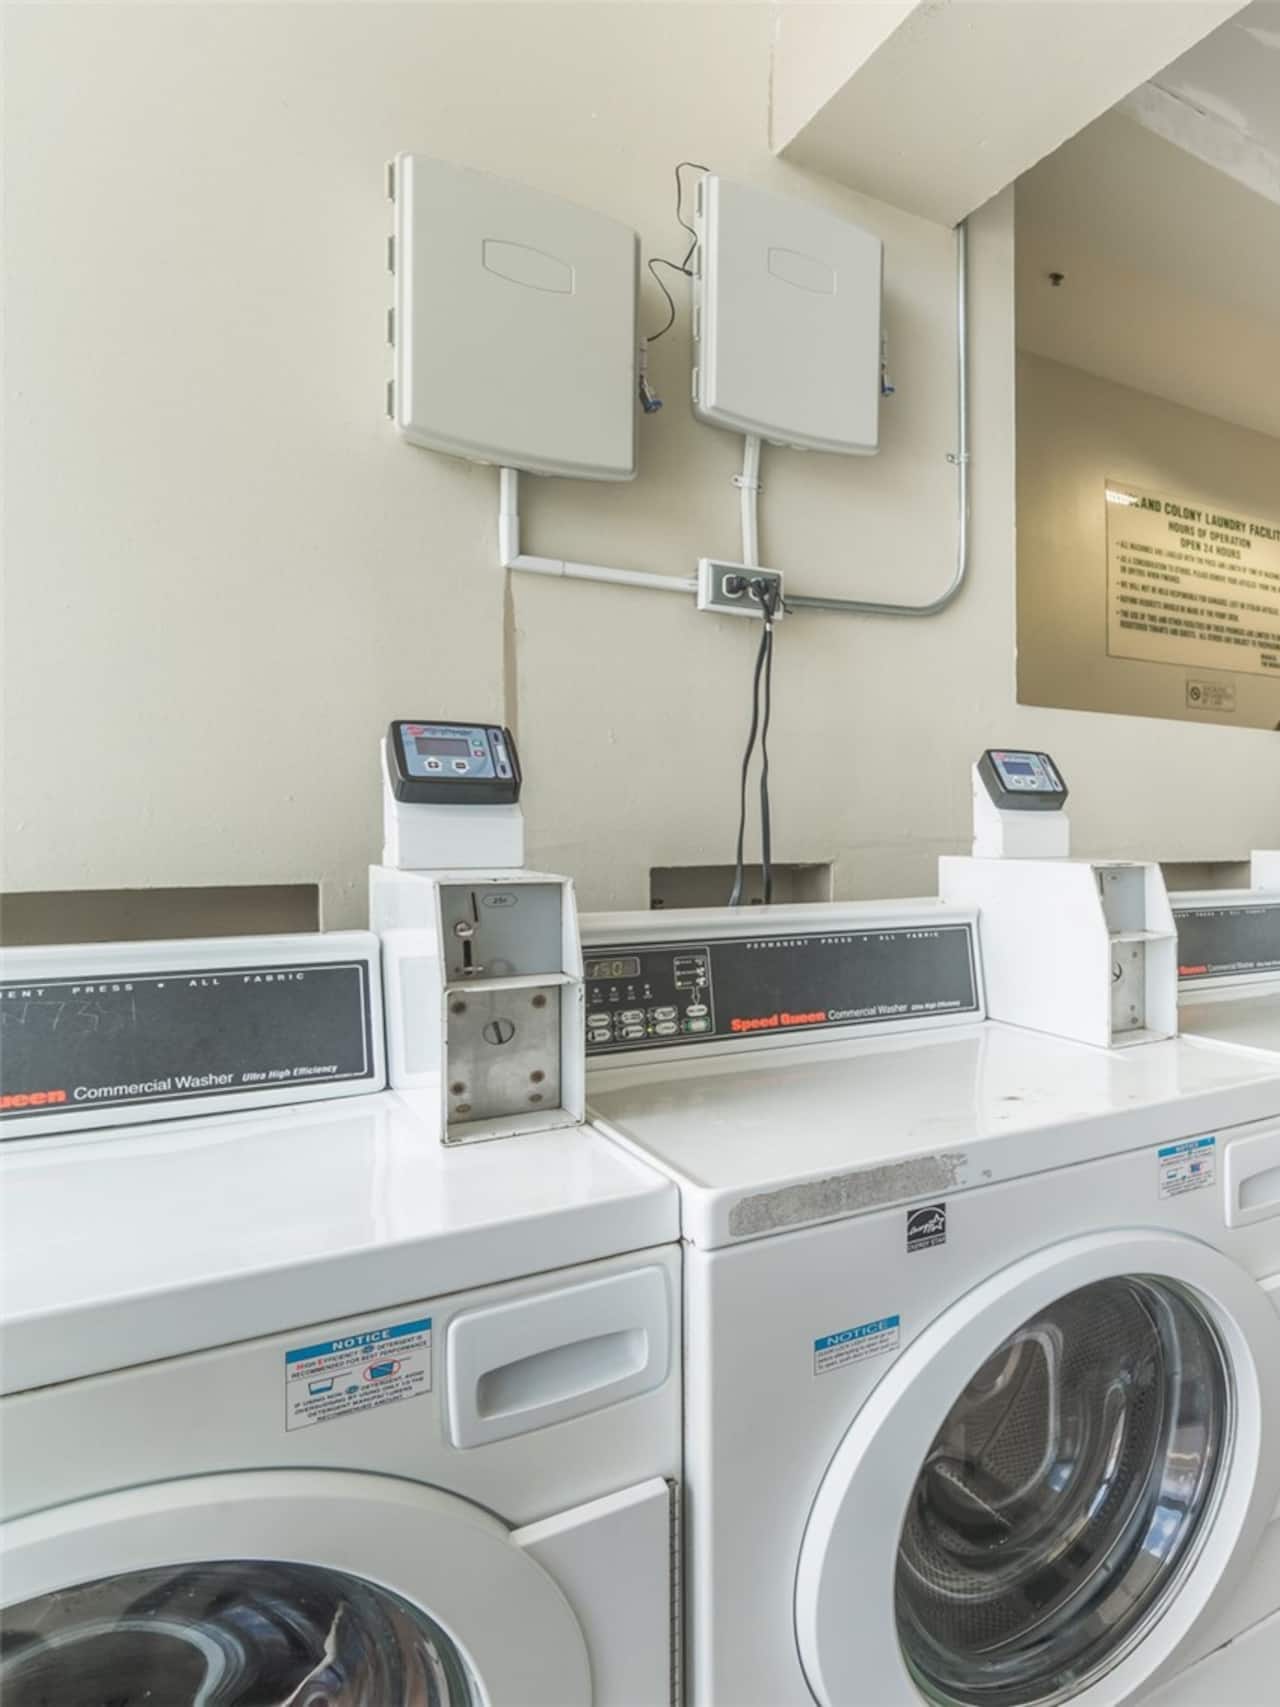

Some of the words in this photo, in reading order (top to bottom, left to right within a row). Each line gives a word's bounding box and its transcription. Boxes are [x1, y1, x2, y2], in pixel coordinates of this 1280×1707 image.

[1164, 502, 1202, 523] COLONY
[1205, 512, 1246, 534] LAUNDRY
[1167, 521, 1195, 537] HOURS
[1197, 528, 1207, 538] OF
[1209, 531, 1251, 550] OPERATION
[1180, 537, 1201, 551] OPEN
[1203, 542, 1214, 554] 24
[1216, 546, 1242, 561] HOURS
[0, 988, 45, 999] ENT
[72, 983, 133, 995] PRESS
[189, 977, 220, 987] ALL
[243, 972, 304, 983] FABRIC
[731, 1013, 779, 1033] Speed
[780, 1010, 827, 1026] Queen
[827, 1005, 877, 1020] Commercial
[878, 1003, 907, 1014] Washer
[73, 1077, 171, 1101] Commercial
[174, 1073, 234, 1090] Washer
[242, 1072, 266, 1083] Ultra
[267, 1069, 291, 1080] High
[293, 1065, 338, 1077] Efficiency
[332, 1329, 391, 1352] NOTICE
[827, 1321, 888, 1346] NOTICE
